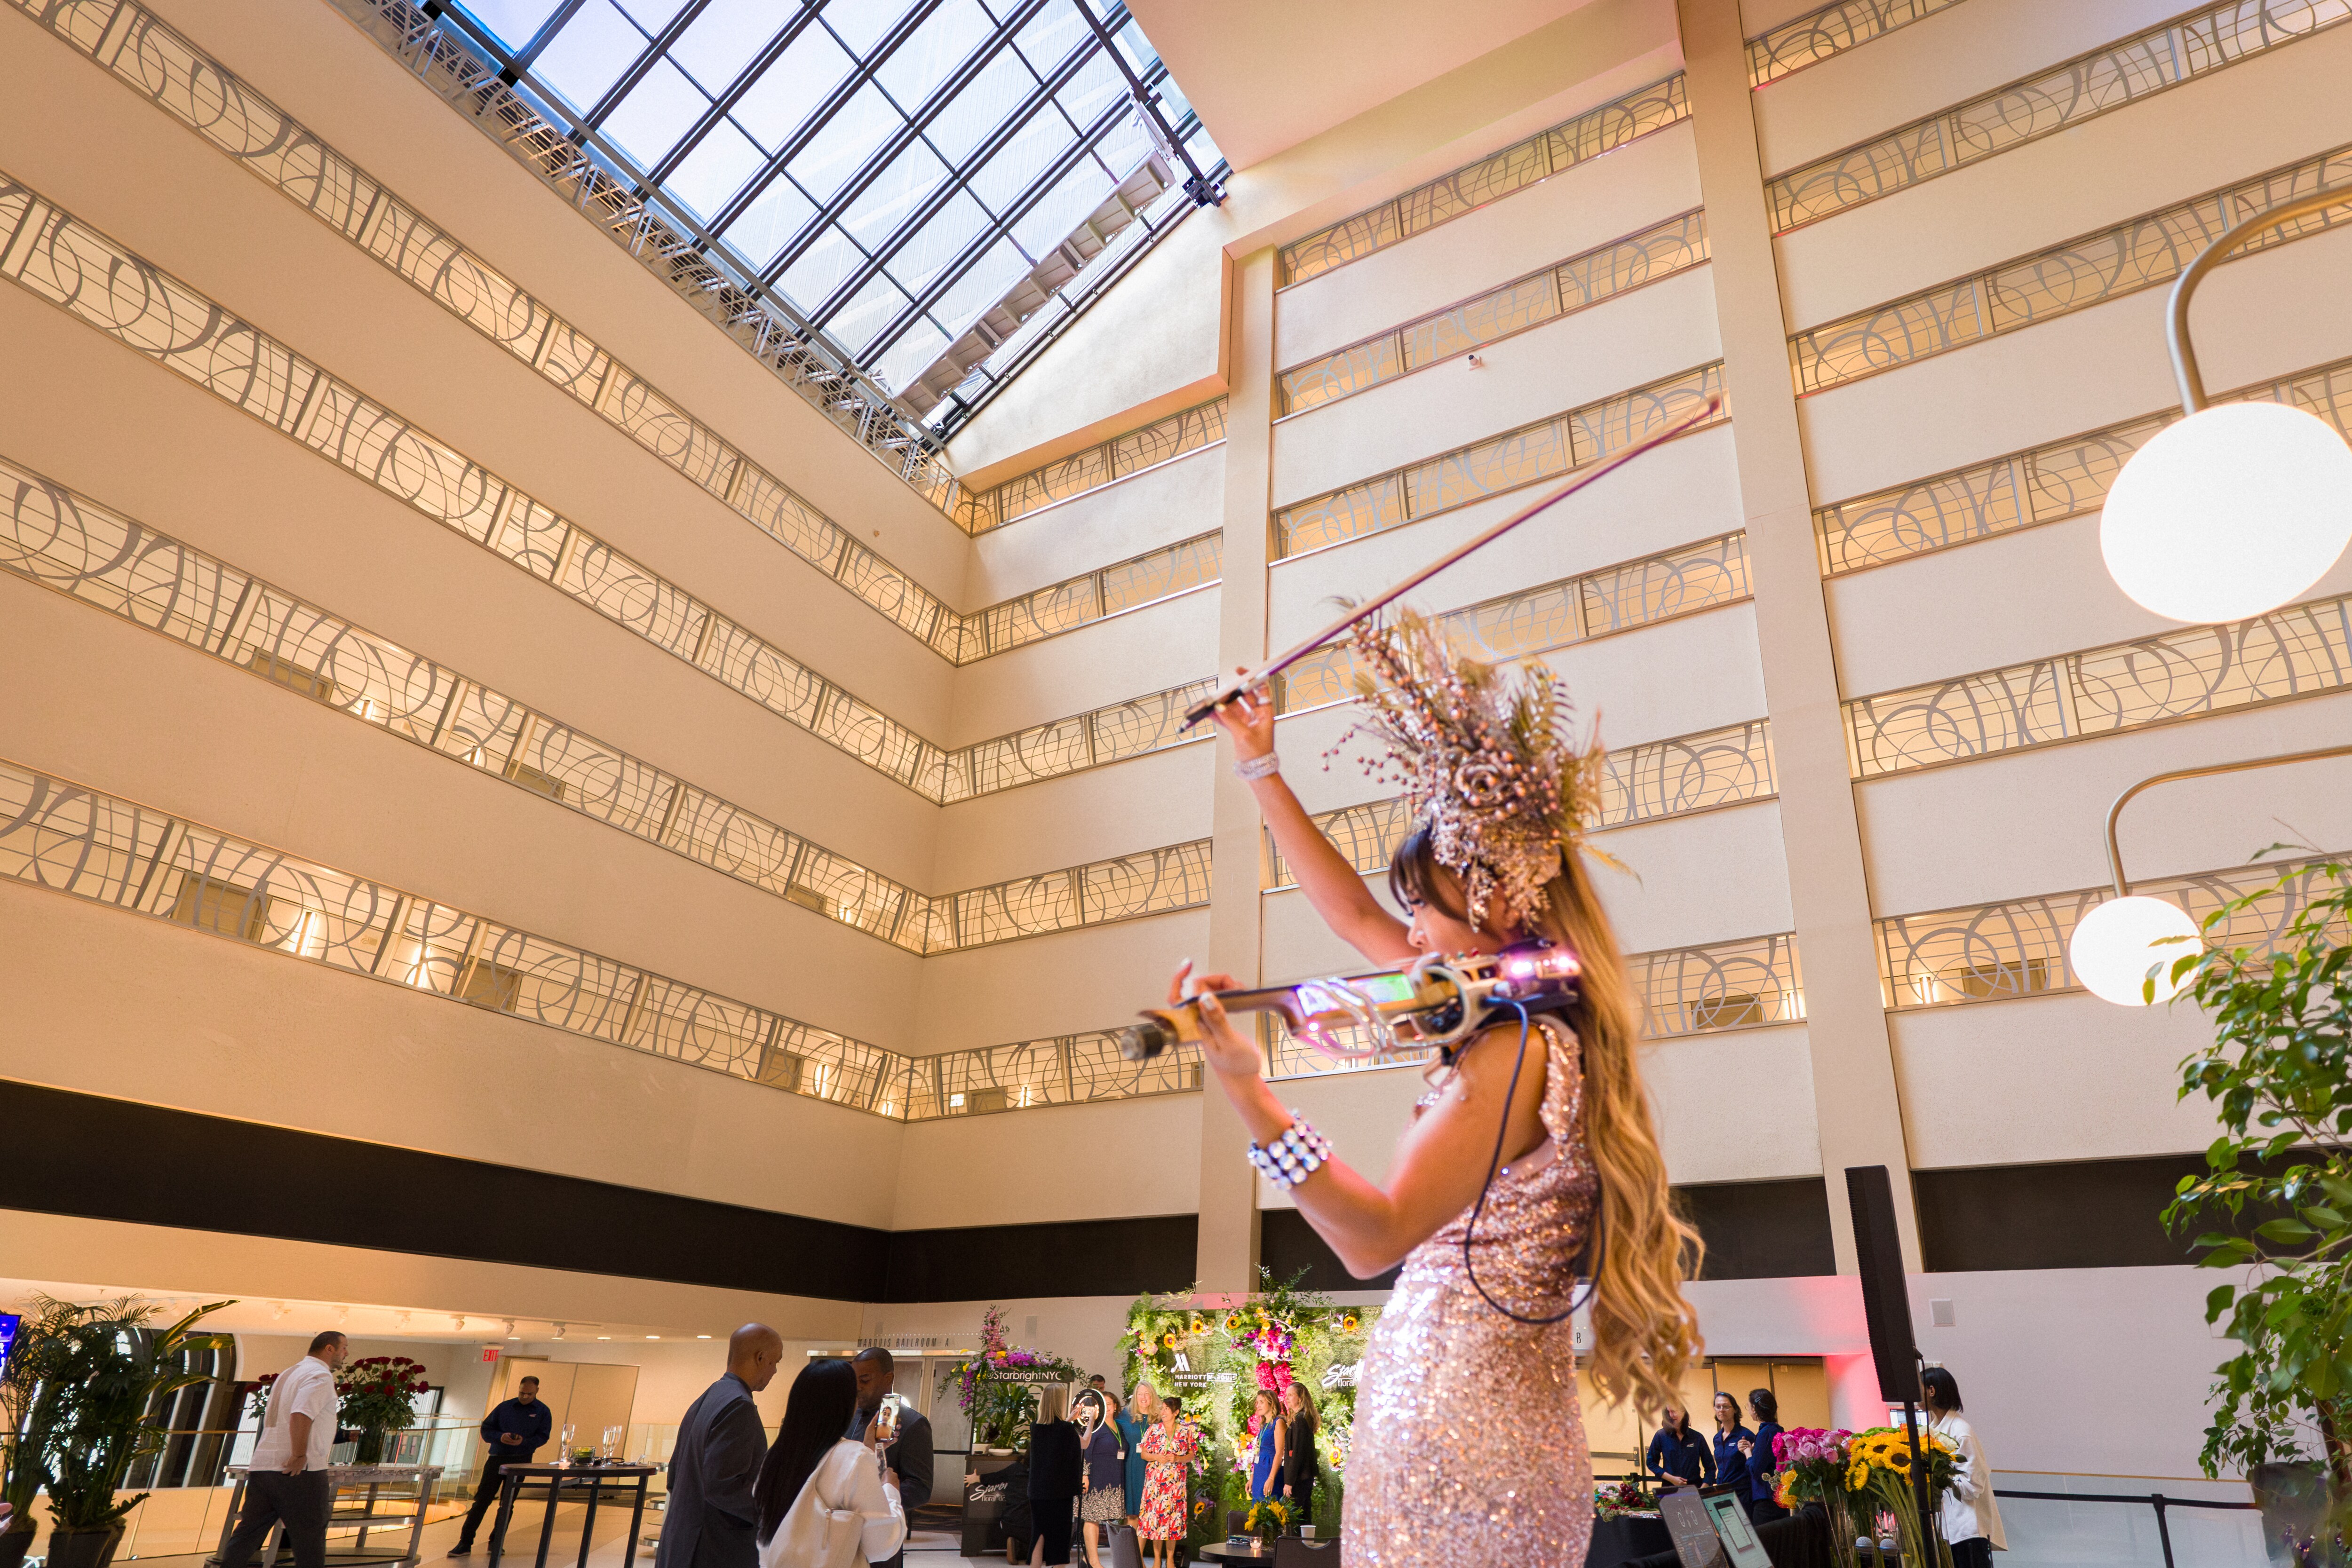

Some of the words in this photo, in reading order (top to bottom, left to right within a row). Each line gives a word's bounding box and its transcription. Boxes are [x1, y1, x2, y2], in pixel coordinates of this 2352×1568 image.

[857, 1338, 891, 1347] MARQUIS
[896, 1338, 937, 1347] BALLROOM
[945, 1338, 949, 1347] A
[1576, 1332, 1581, 1344] B
[483, 1349, 499, 1362] EXIT
